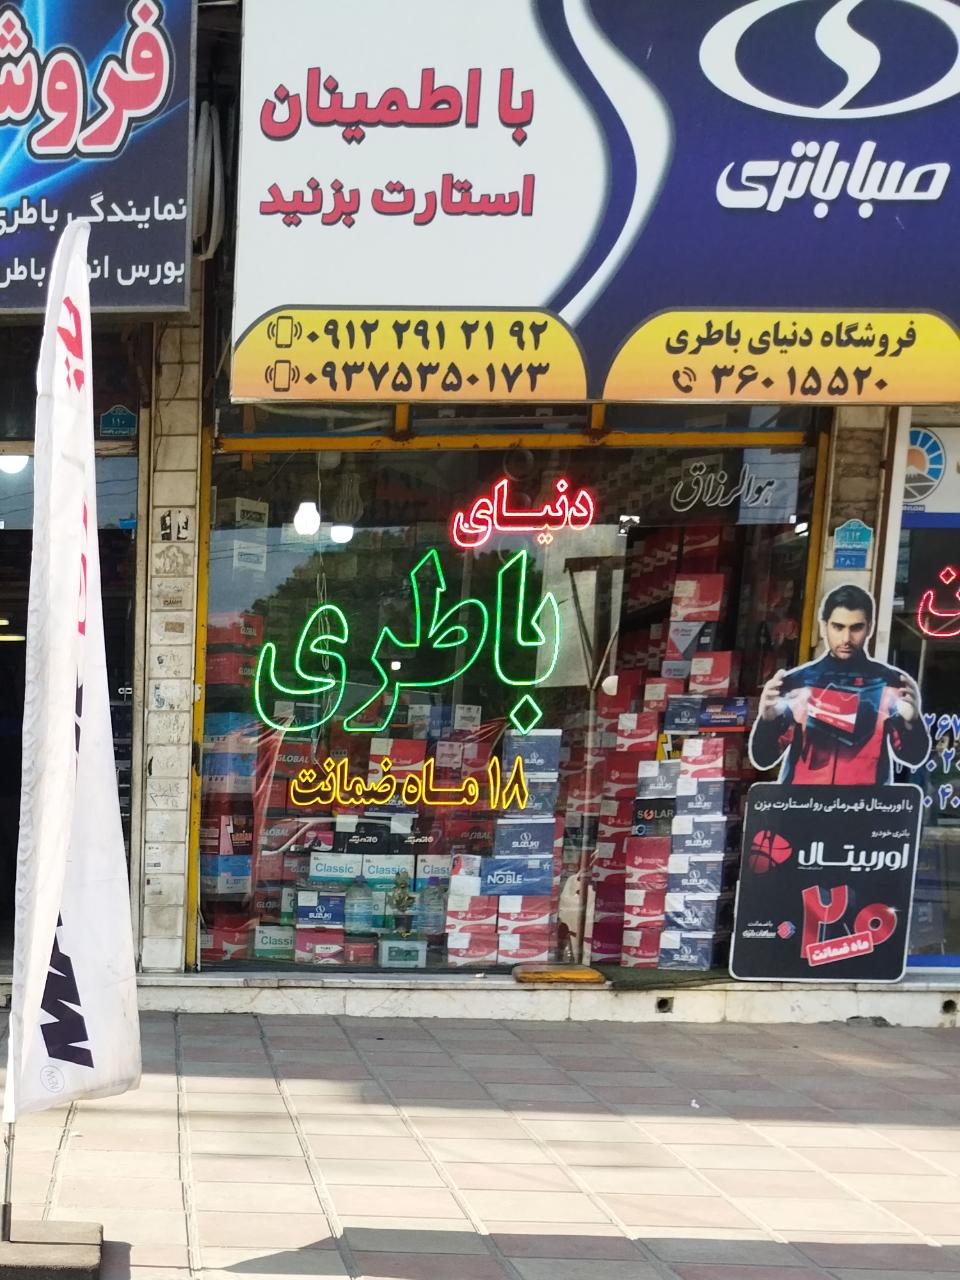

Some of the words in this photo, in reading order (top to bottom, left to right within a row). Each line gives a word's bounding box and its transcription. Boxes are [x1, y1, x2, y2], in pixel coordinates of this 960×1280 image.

[260, 67, 482, 145] اطمینان
[498, 68, 535, 146] با
[67, 192, 188, 229] نمایندگی
[259, 177, 360, 228] بزنید
[371, 174, 535, 226] استارت
[116, 261, 186, 287] بورس
[307, 319, 379, 350] ۰۹۱۲
[392, 319, 446, 350] ۲۹۱
[460, 319, 495, 350] ۲۱
[509, 319, 548, 350] ۹۲
[665, 319, 740, 355] باطری
[748, 320, 813, 355] دنیای
[821, 319, 917, 357] فروشگاه
[303, 361, 550, 393] ۰۹۳۷۵۳۵۰۱۷۳
[453, 478, 594, 548] دنیای
[255, 549, 561, 735] باطری
[289, 756, 398, 806] ضمانت
[401, 756, 479, 806] ماه
[486, 755, 530, 810] ۱۸
[511, 841, 540, 849] SUZUKI
[797, 841, 910, 872] اوربیتال
[314, 862, 355, 874] Classic
[422, 864, 451, 875] Class
[487, 873, 523, 884] NOBLE
[308, 912, 332, 920] SUZUKI
[800, 884, 898, 959] ۲۰
[260, 935, 293, 946] Classi
